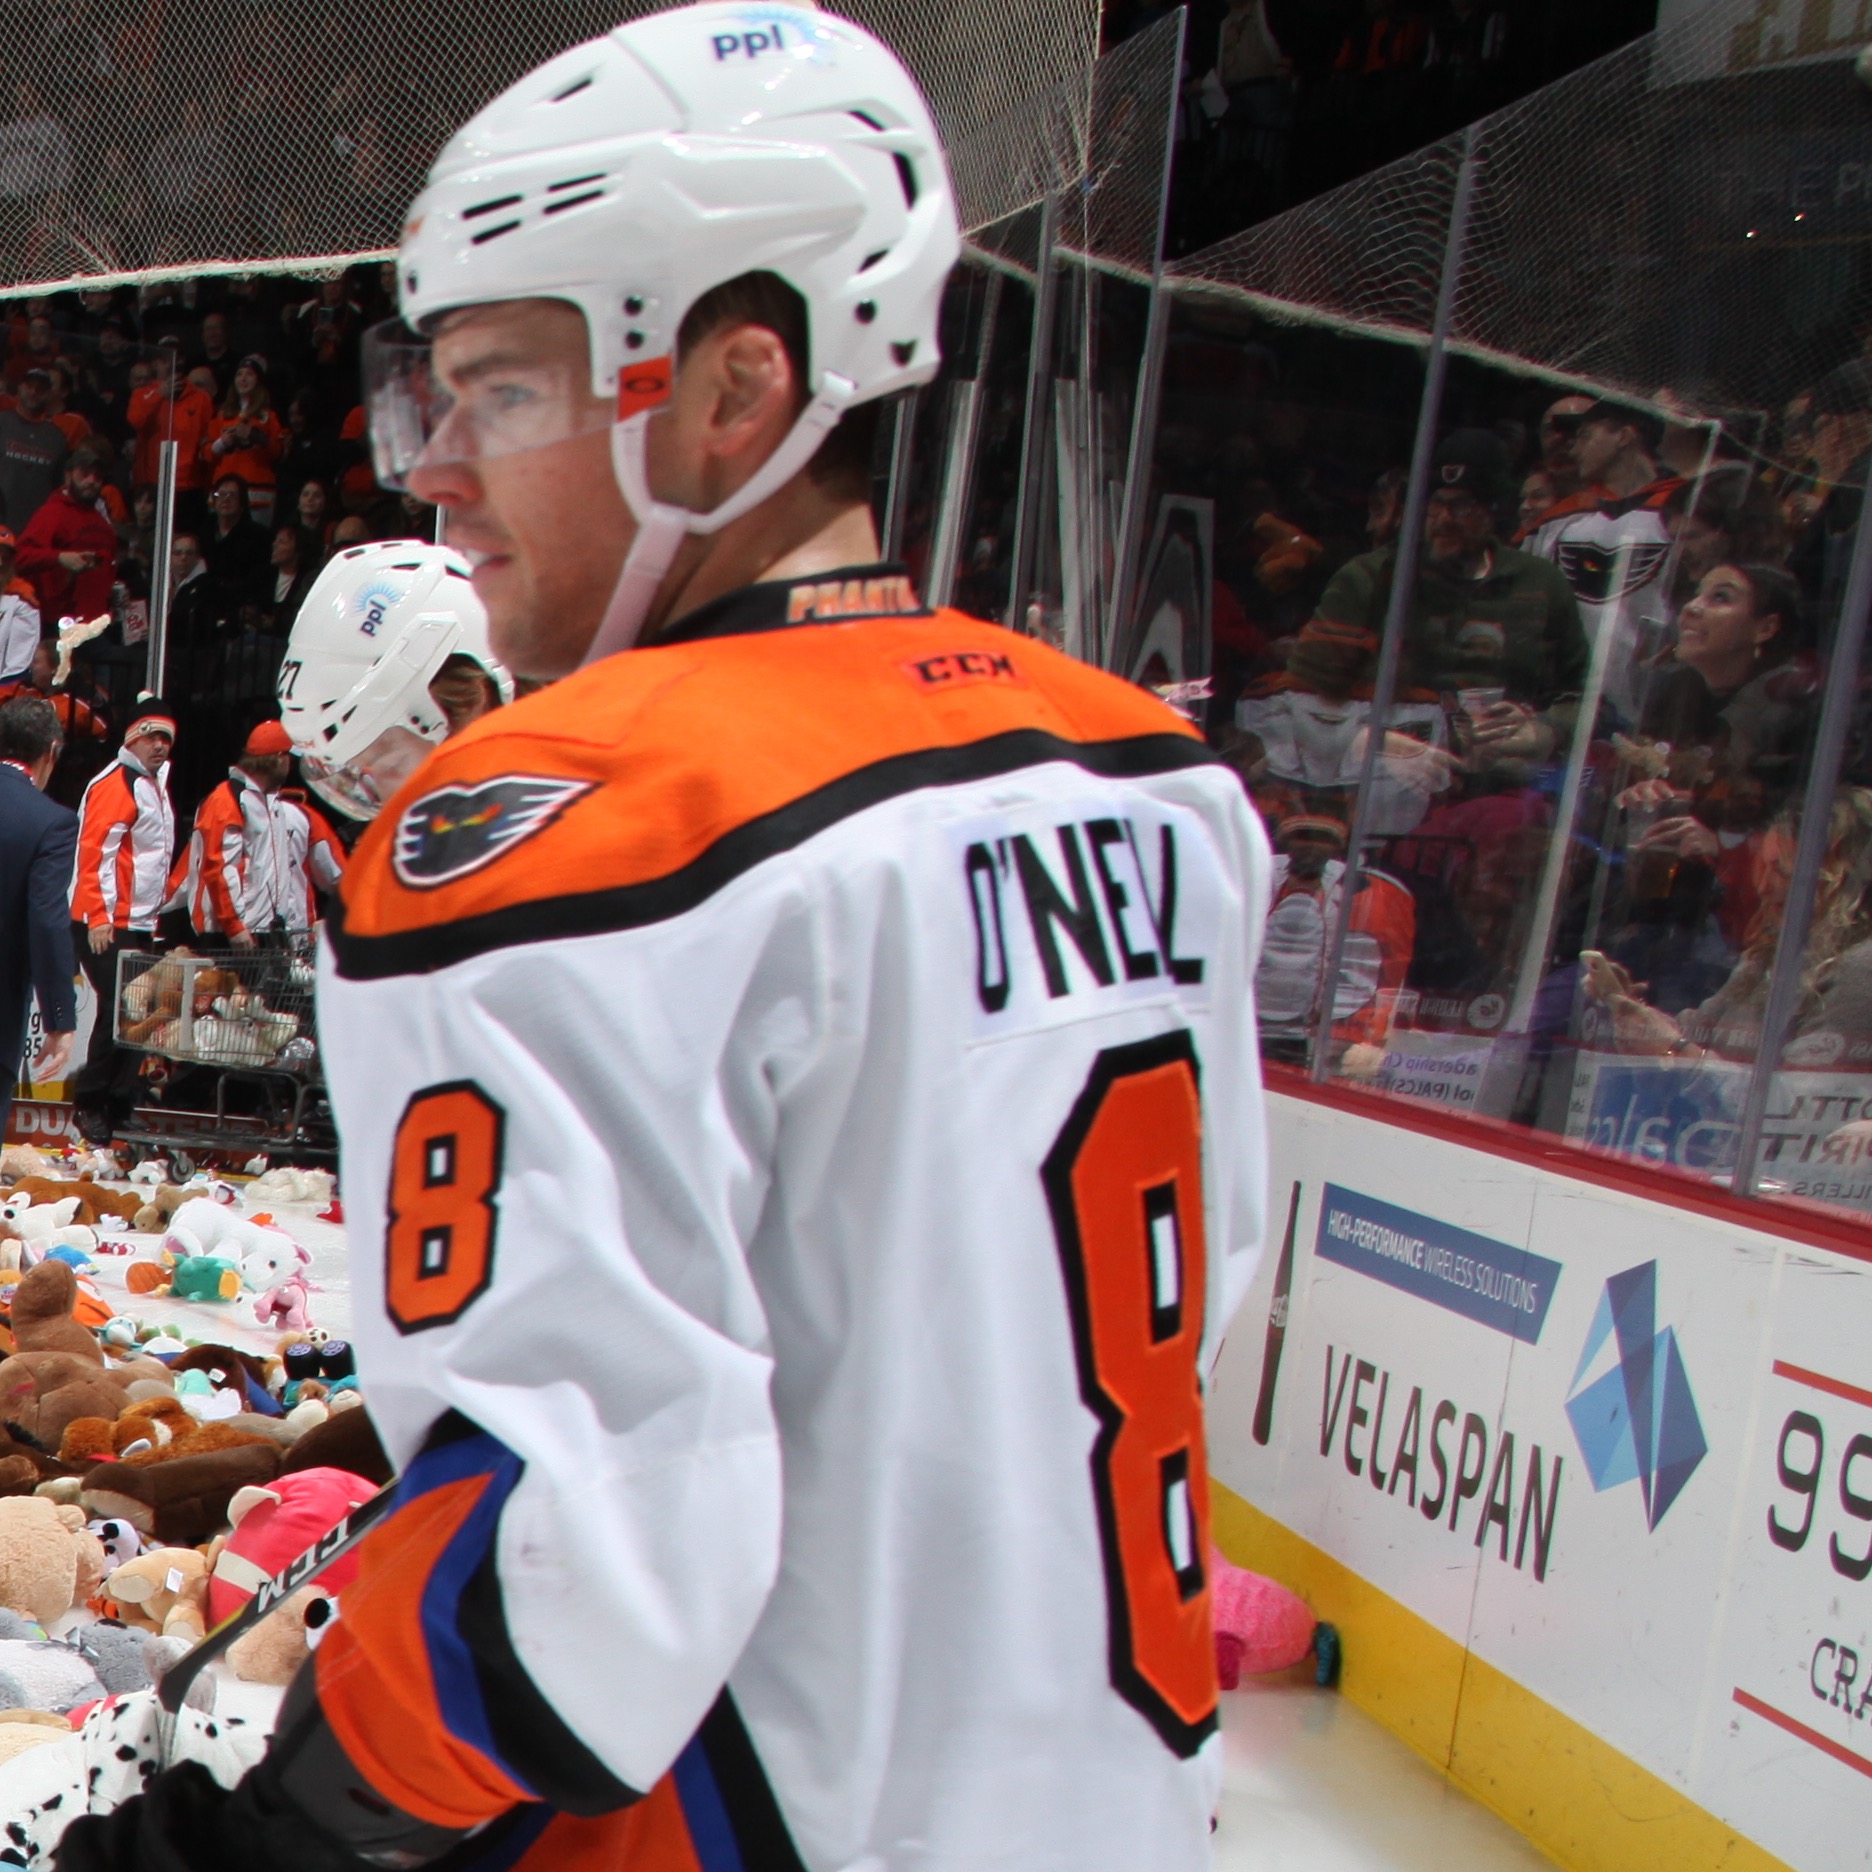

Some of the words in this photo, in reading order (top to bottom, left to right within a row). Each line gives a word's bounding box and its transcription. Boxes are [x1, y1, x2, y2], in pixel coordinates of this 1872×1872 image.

[713, 24, 784, 60] ppl
[359, 600, 386, 637] ppl
[914, 653, 1016, 684] CCM
[383, 1078, 509, 1337] 8
[1327, 1209, 1425, 1270] HIGH-PERFORMANCE
[1423, 1245, 1476, 1290] WIRELESS
[1474, 1262, 1538, 1315] SOLUTIONS
[1038, 1027, 1219, 1759] 8
[1320, 1344, 1563, 1584] VELASPAN
[257, 1516, 354, 1612] CCM
